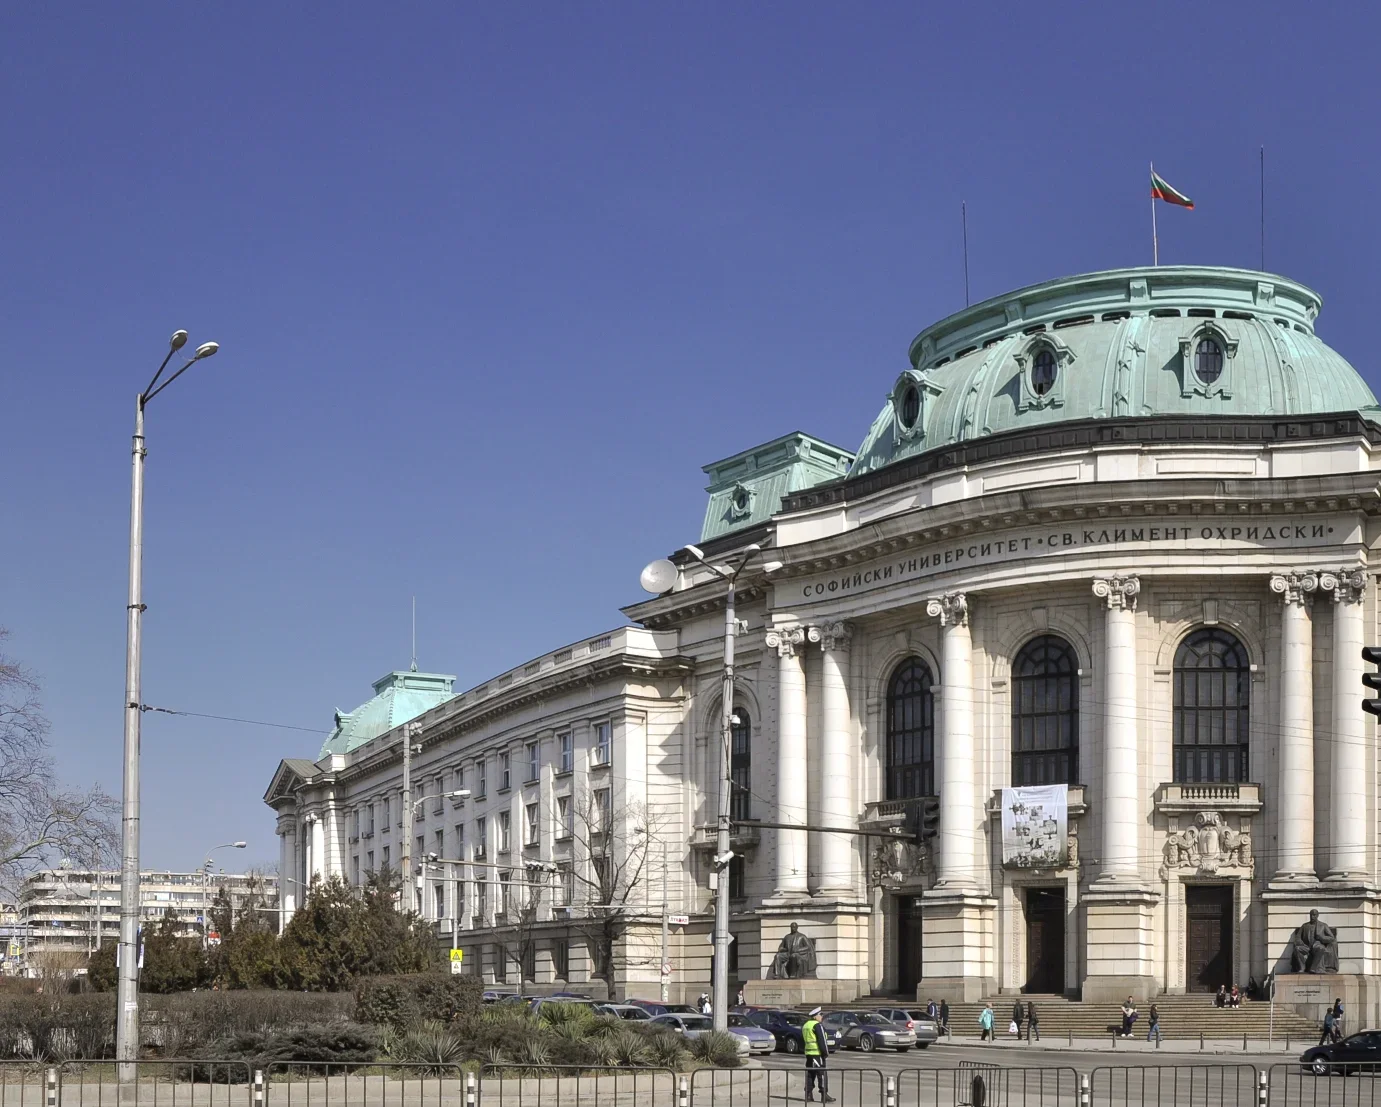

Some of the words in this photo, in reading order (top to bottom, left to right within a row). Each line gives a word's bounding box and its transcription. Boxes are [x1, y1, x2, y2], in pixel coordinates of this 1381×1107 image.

[803, 565, 893, 597] СОФИЙСКИ
[899, 537, 1032, 574] УНИВЕРСИТЕТ
[1047, 532, 1077, 547] СВ.
[1083, 527, 1192, 544] КЛИМЕНТ
[1201, 525, 1324, 540] ОХРИДСКИ
